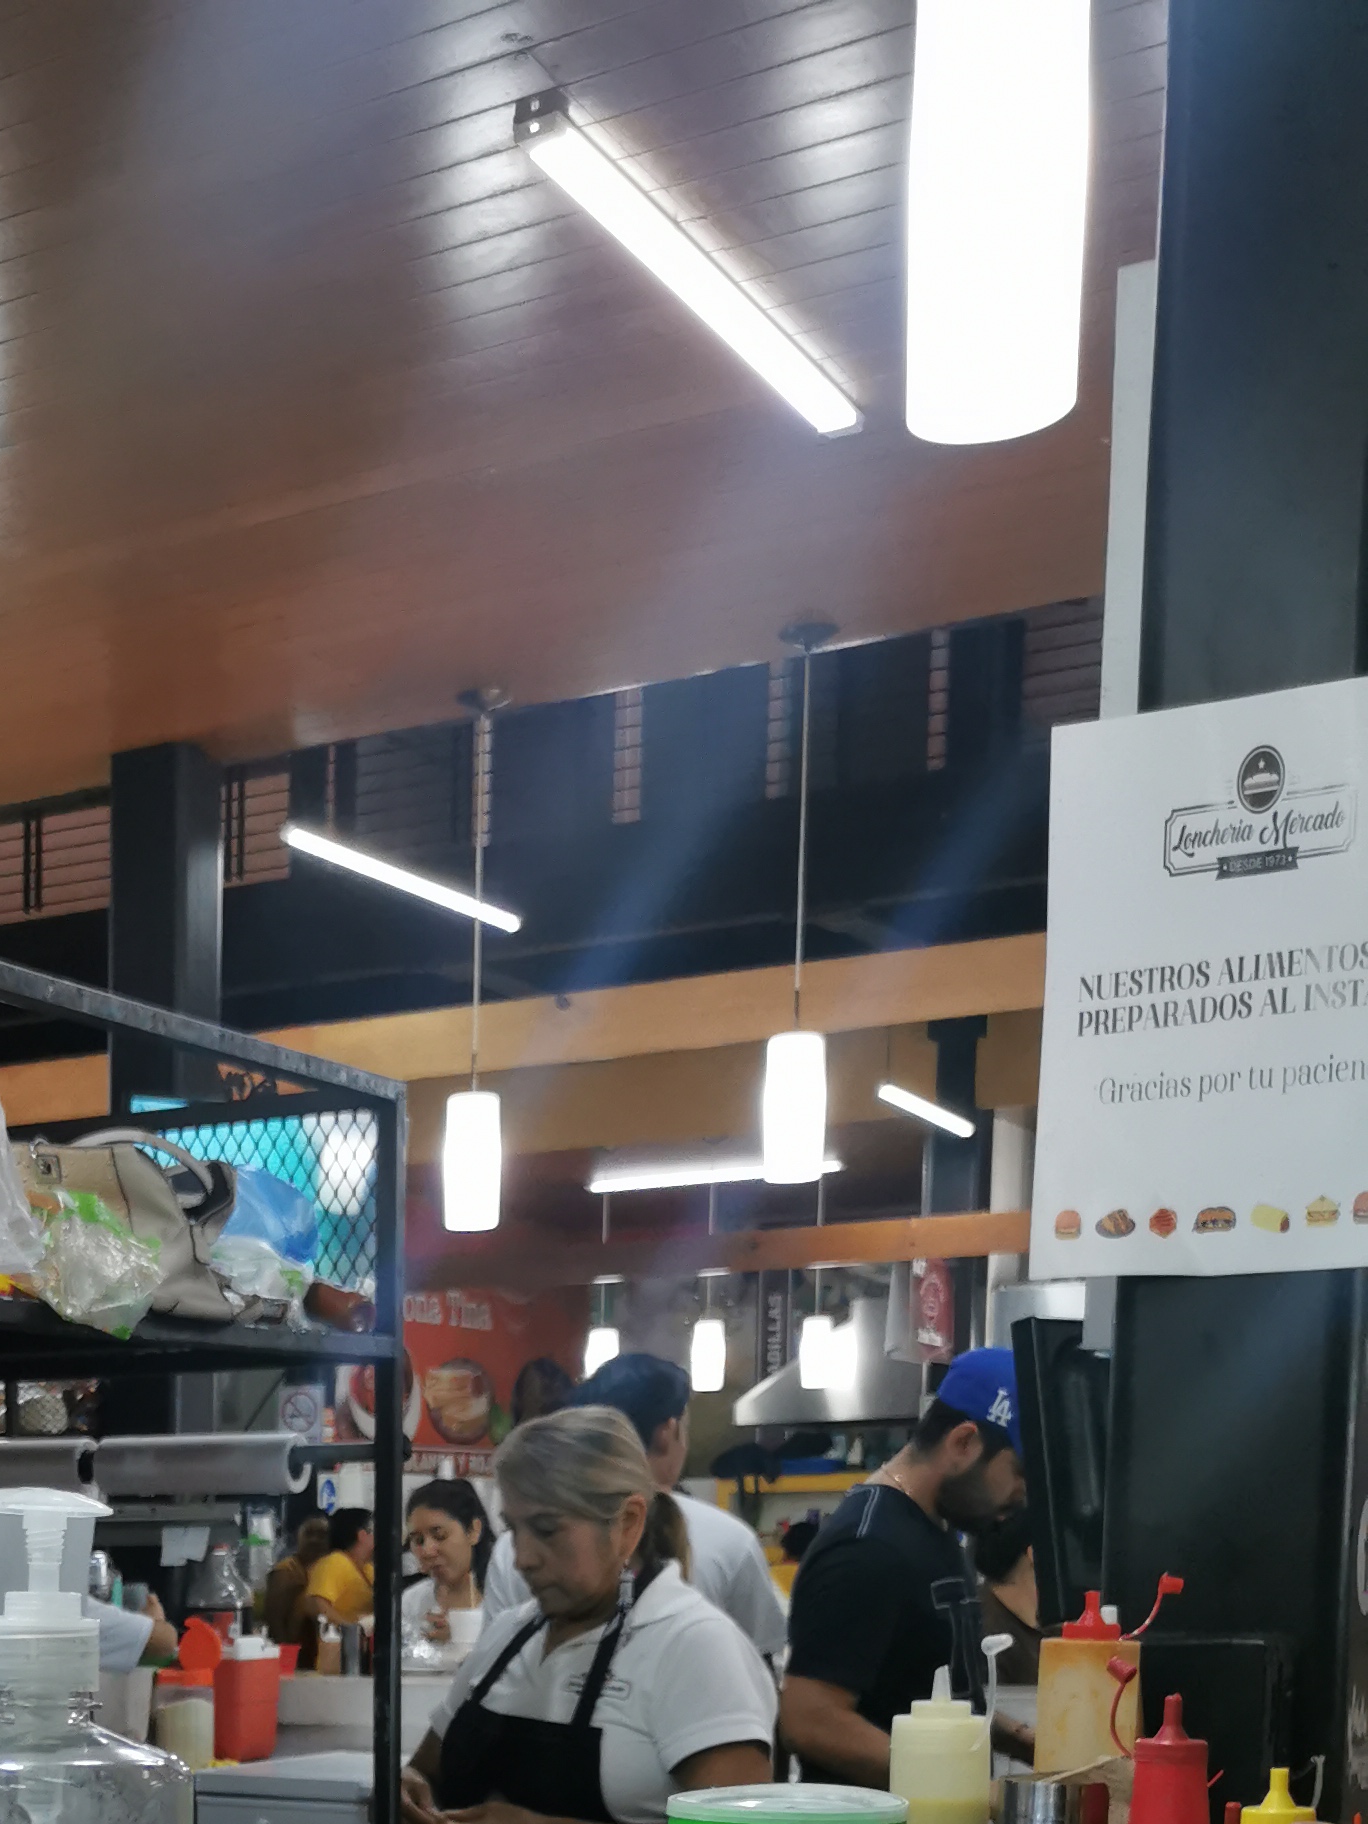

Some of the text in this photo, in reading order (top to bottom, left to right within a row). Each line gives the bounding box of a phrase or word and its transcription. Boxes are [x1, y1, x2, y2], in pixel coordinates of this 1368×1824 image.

[1259, 800, 1347, 849] Mercado
[1229, 856, 1263, 875] DESDE
[1078, 959, 1211, 1003] NUESTROS
[1076, 990, 1253, 1038] PREPARADOS
[1258, 986, 1297, 1018] AL
[1098, 1071, 1193, 1105] Gracias
[1197, 1070, 1242, 1103] por
[1248, 1065, 1274, 1091] tu
[985, 1386, 1013, 1428] LA
